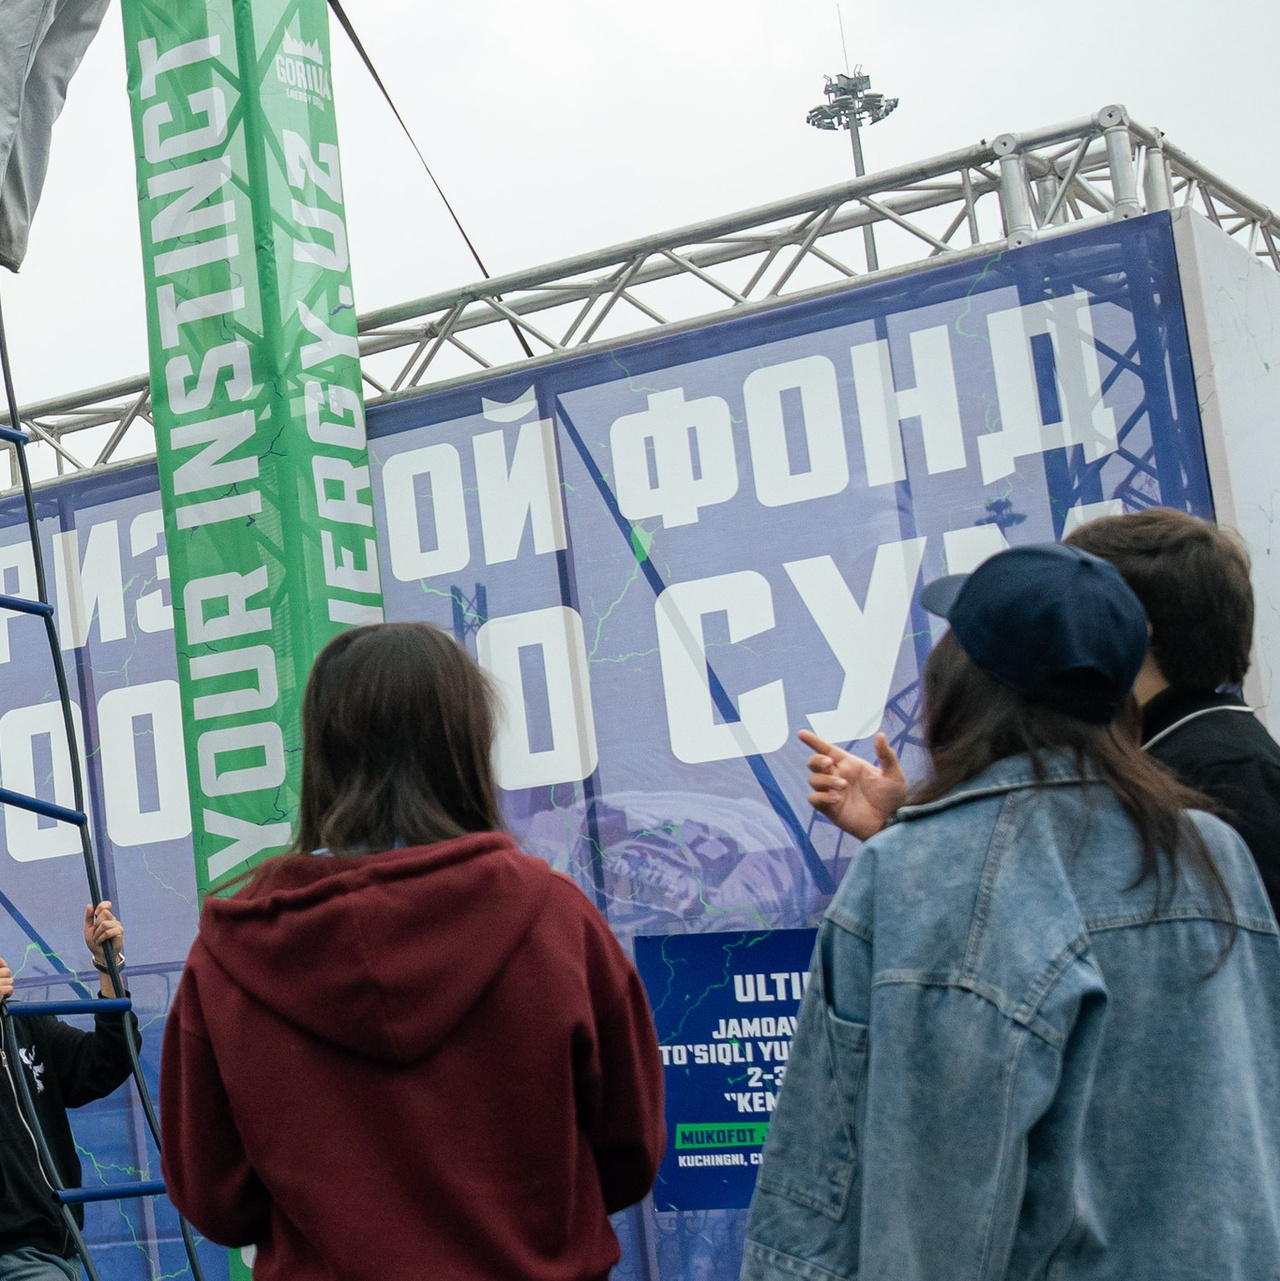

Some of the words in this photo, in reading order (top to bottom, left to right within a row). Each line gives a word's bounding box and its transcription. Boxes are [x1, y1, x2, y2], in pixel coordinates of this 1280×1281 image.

[137, 34, 263, 530] INSTINCT
[609, 285, 1120, 529] ФОНД
[183, 564, 294, 882] YOUR
[654, 499, 1125, 765] СУ
[678, 1154, 748, 1167] KUCHINGNI,
[680, 1128, 756, 1145] MUKOFOT
[757, 1040, 792, 1061] YU
